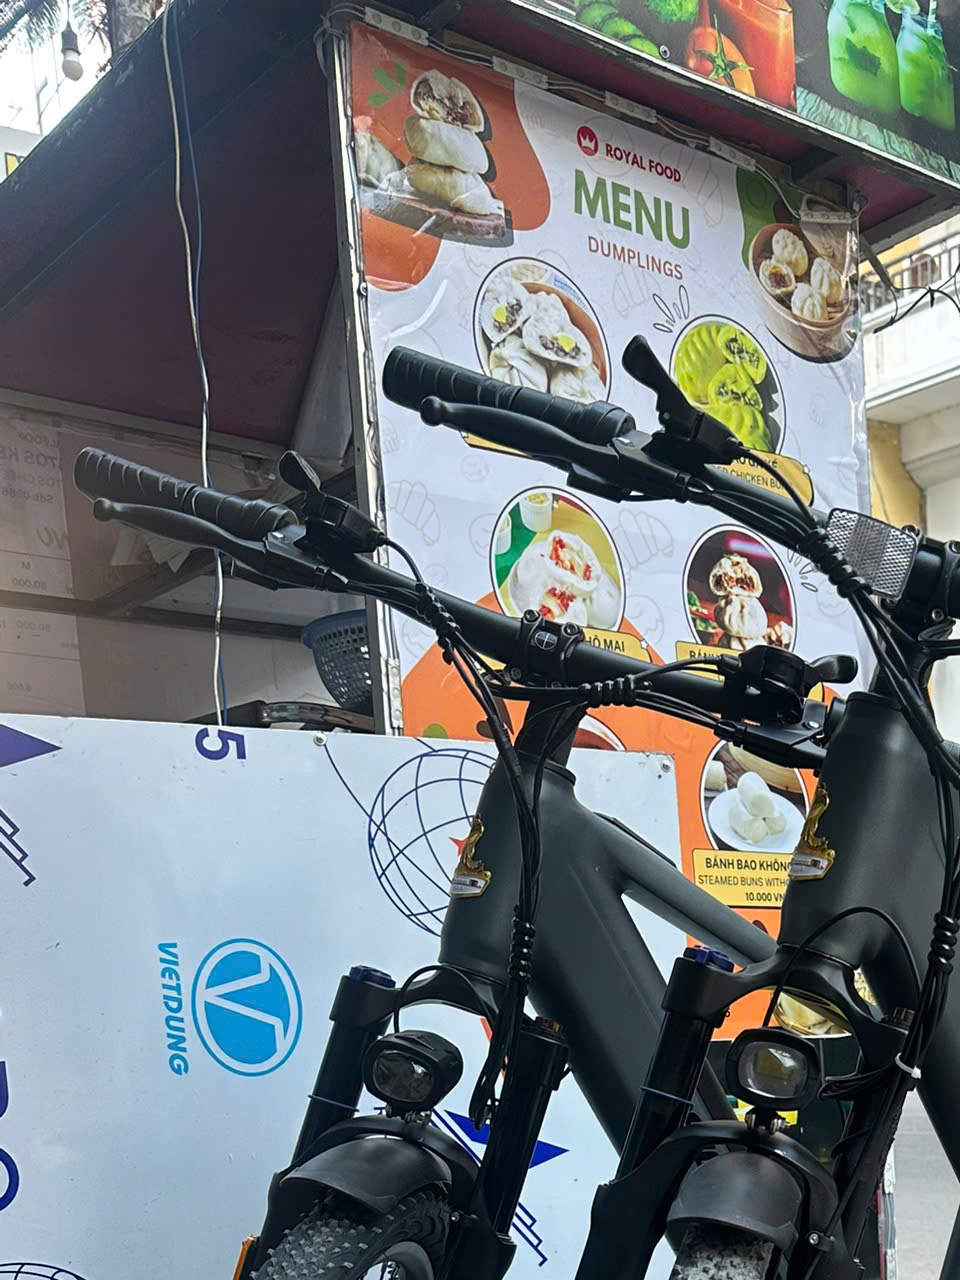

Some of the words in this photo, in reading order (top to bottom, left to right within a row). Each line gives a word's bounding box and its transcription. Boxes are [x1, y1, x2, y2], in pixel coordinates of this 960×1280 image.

[605, 143, 646, 171] ROYAL
[649, 159, 682, 183] FOOD
[574, 167, 691, 250] MENU
[588, 235, 684, 281] DUMPLINGS
[730, 468, 769, 487] CHICKEN
[603, 638, 625, 652] MAI
[195, 727, 246, 760] 5
[705, 855, 735, 870] BÁNH
[737, 859, 757, 871] BAO
[698, 874, 739, 886] STEAMED
[740, 876, 764, 887] BUNS
[745, 892, 773, 902] 10.000
[158, 942, 189, 1076] VIETDUNG
